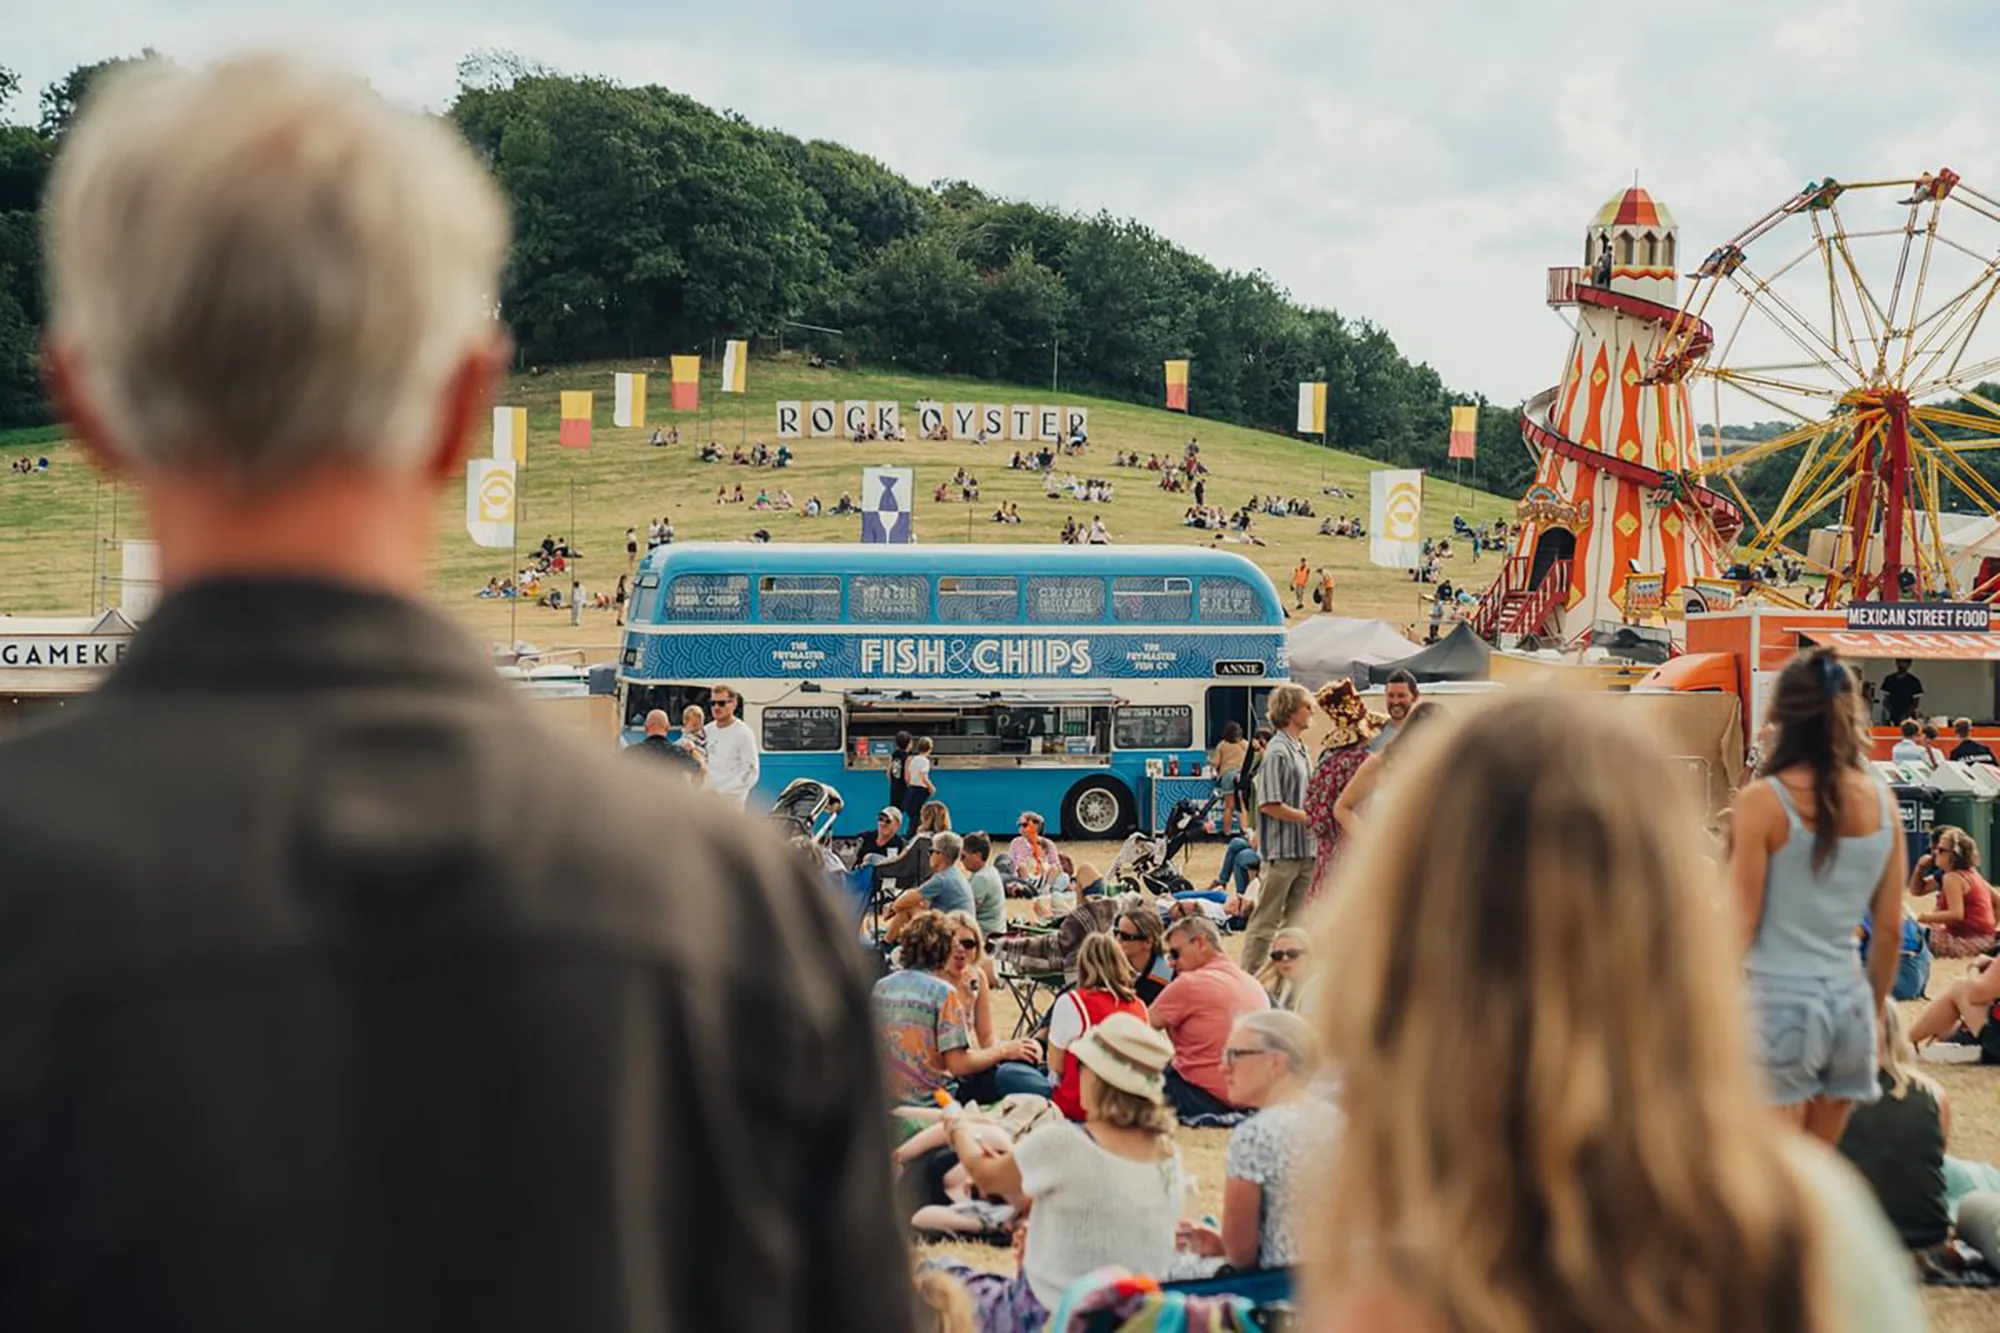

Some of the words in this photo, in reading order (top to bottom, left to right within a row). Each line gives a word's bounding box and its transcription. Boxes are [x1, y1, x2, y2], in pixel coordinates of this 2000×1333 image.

[779, 405, 897, 433] ROCK
[922, 408, 1085, 437] OYSTER
[1848, 608, 1906, 625] MEXICAN
[1907, 608, 1953, 626] STREET
[1955, 610, 1988, 627] FOOD
[861, 640, 945, 673] FISH
[973, 640, 1091, 673] CHIPS
[1221, 664, 1260, 673] ANNIE
[800, 708, 839, 719] MENU
[1152, 707, 1189, 717] MENU
